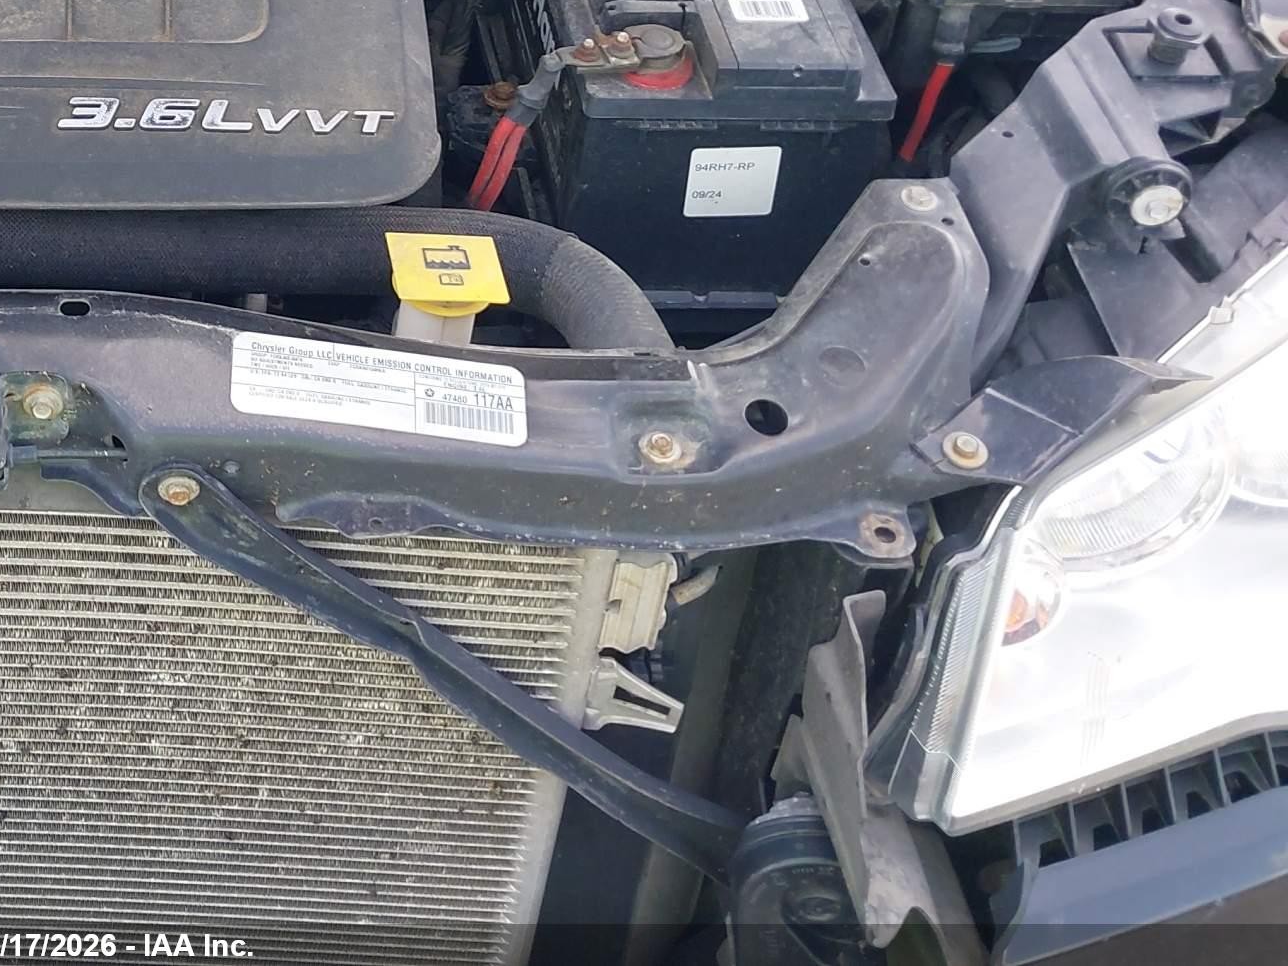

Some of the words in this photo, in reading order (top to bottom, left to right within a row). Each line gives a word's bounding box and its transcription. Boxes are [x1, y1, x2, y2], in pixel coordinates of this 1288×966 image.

[695, 162, 756, 172] 94RH7-RP
[692, 190, 722, 199] 09/24
[251, 341, 285, 354] Chrysler
[288, 345, 313, 358] Group
[317, 350, 332, 359] LLC
[336, 352, 369, 364] VEHICLE
[372, 357, 411, 370] EMISSION
[414, 363, 452, 376] CONTROL
[455, 369, 512, 384] INFORMATION
[474, 394, 513, 410] 117AA
